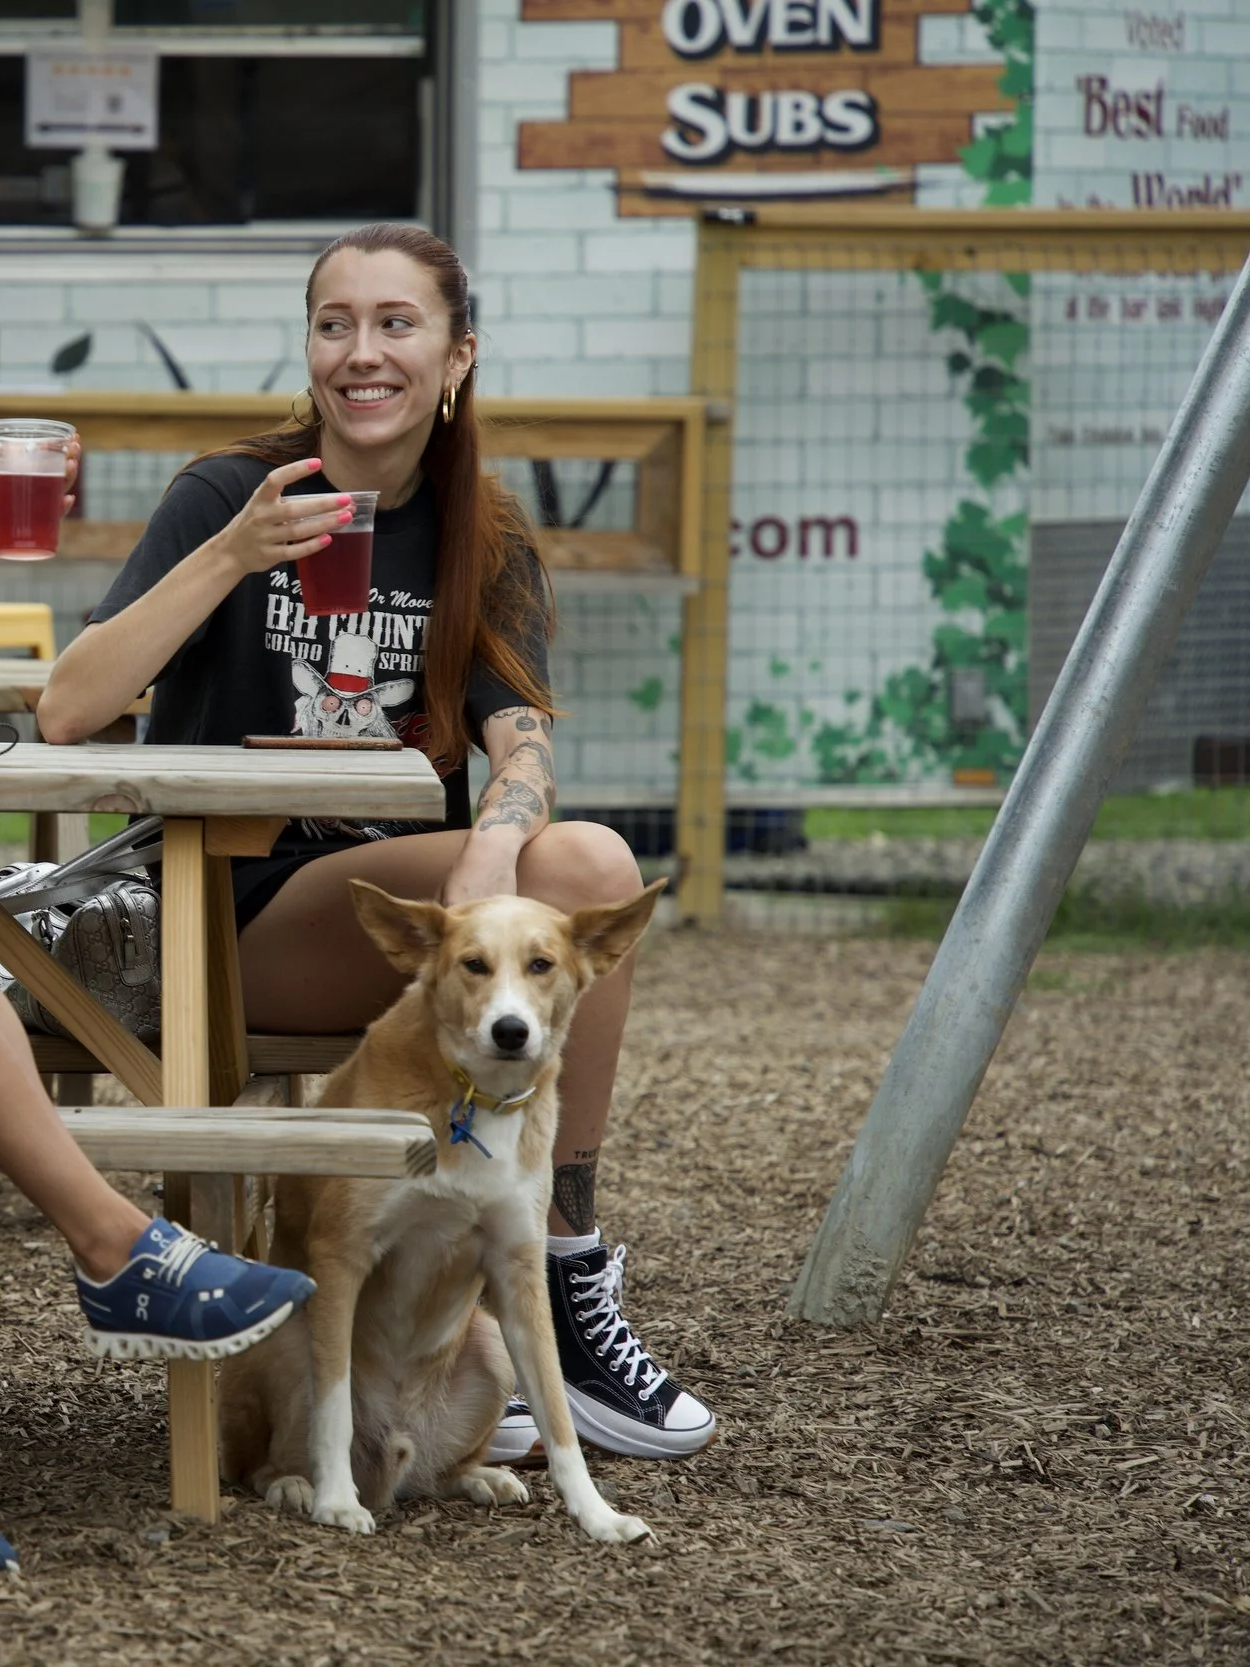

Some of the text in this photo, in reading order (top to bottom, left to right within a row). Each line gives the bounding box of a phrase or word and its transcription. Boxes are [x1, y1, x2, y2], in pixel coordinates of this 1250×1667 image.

[661, 0, 879, 58] OVEN
[659, 82, 877, 165] SUBS
[1177, 104, 1229, 143] Food
